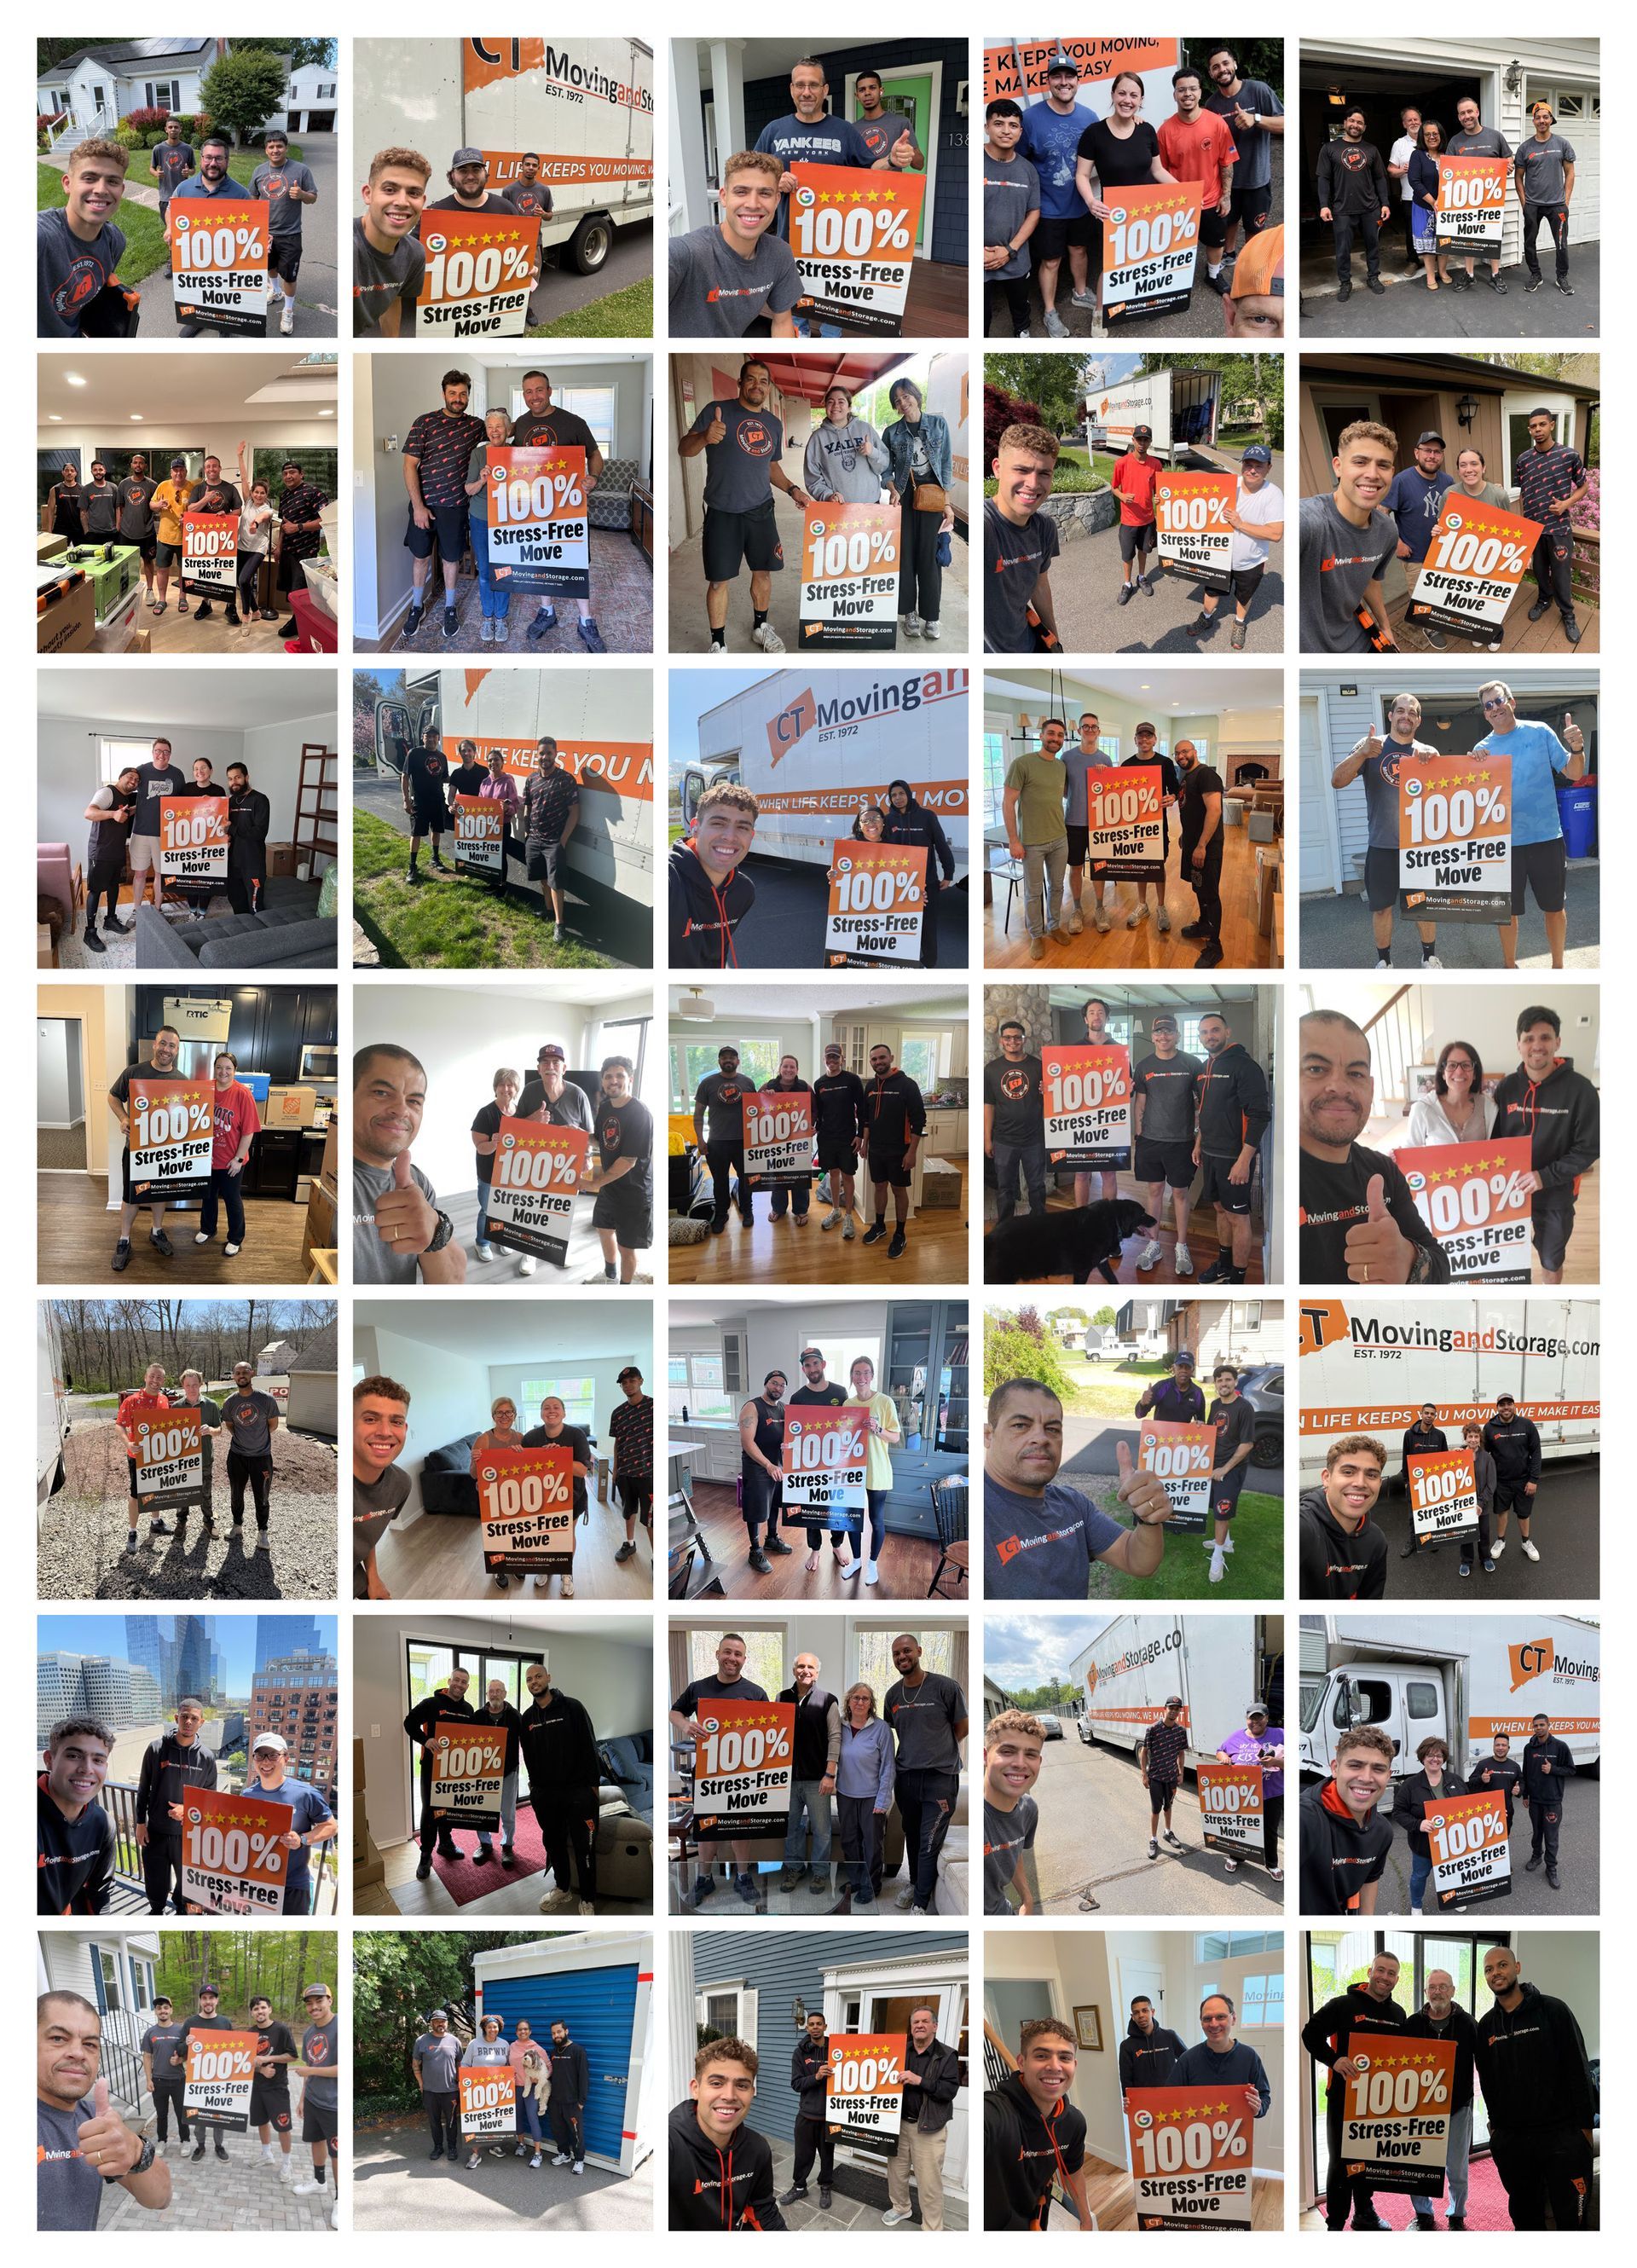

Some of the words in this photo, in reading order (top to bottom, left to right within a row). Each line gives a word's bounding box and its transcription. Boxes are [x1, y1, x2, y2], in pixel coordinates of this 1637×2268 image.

[998, 48, 1059, 71] KEEPS
[1063, 43, 1096, 61] YOU
[1102, 38, 1160, 52] MOVING,
[546, 84, 564, 98] EST.
[566, 90, 584, 103] 1972
[773, 136, 842, 153] YANKEES
[496, 161, 524, 179] LIF
[542, 163, 586, 177] KEEPS
[588, 163, 610, 176] YOU
[613, 165, 646, 176] MOVING,
[1442, 177, 1501, 208] 100%
[1440, 210, 1501, 223] Stress-Free
[795, 208, 910, 256] 100%
[1109, 208, 1195, 265] 100%
[1457, 223, 1485, 234] Move
[176, 227, 263, 269] 100%
[178, 273, 263, 287] Stress-Free
[425, 245, 529, 299] 100%
[796, 260, 904, 283] Stress-Free
[1109, 252, 1193, 288] Stress-Free
[824, 282, 874, 300] Move
[1135, 273, 1172, 295] Move
[202, 290, 241, 304] Move
[424, 293, 524, 324] Stress-Free
[454, 316, 500, 338] Move
[492, 473, 582, 523] 100%
[1160, 497, 1229, 530] 100%
[185, 531, 234, 556] 100%
[494, 522, 583, 546] Stress-Free
[1161, 534, 1229, 547] Stress-Free
[185, 558, 234, 569] Stress-Free
[520, 545, 562, 562] Move
[809, 530, 895, 577] 100%
[1179, 547, 1211, 560] Move
[1434, 531, 1527, 575] 100%
[199, 570, 222, 580] Move
[1423, 571, 1511, 599] Stress-Free
[807, 576, 894, 601] Stress-Free
[833, 599, 874, 617] Move
[1443, 592, 1485, 610] Move
[777, 706, 805, 742] CT
[818, 732, 835, 742] EST.
[838, 726, 859, 738] 1972
[574, 753, 629, 781] YOU
[760, 798, 789, 810] WHEN
[791, 797, 816, 809] LIFE
[820, 796, 867, 809] KEEPS
[1091, 787, 1158, 826] 100%
[1405, 785, 1506, 844] 100%
[164, 816, 225, 847] 100%
[457, 815, 500, 839] 100%
[1093, 824, 1159, 844] Stress-Free
[165, 847, 225, 862] Stress-Free
[456, 841, 500, 852] Stress-Free
[469, 852, 489, 862] Move
[1113, 842, 1143, 857] Move
[1406, 842, 1506, 869] Stress-Free
[182, 860, 211, 873] Move
[1436, 866, 1482, 886] Move
[836, 871, 919, 911] 100%
[833, 916, 917, 932] Stress-Free
[857, 934, 896, 951] Move
[1048, 1067, 1125, 1113] 100%
[135, 1103, 211, 1146] 100%
[747, 1108, 807, 1145] 100%
[1050, 1107, 1126, 1133] Stress-Free
[1073, 1129, 1108, 1145] Move
[136, 1142, 210, 1166] Stress-Free
[748, 1142, 808, 1160] Stress-Free
[159, 1160, 192, 1177] Move
[499, 1150, 576, 1188] 100%
[766, 1157, 795, 1170] Move
[494, 1190, 571, 1212] Stress-Free
[512, 1209, 549, 1227] Move
[1451, 1250, 1500, 1272] Move
[1354, 1350, 1377, 1358] EST.
[1380, 1350, 1402, 1359] 1972
[1312, 1414, 1351, 1427] LIFE
[1357, 1411, 1411, 1425] KEEPS
[1453, 1407, 1498, 1422] MOVIN
[1516, 1408, 1534, 1418] WE
[1537, 1406, 1568, 1416] MAKE
[1570, 1405, 1579, 1415] IT
[140, 1426, 198, 1463] 100%
[789, 1430, 864, 1469] 100%
[141, 1457, 200, 1480] Stress-Free
[1142, 1444, 1209, 1476] 100%
[159, 1473, 187, 1489] Move
[787, 1471, 862, 1488] Stress-Free
[1414, 1467, 1472, 1506] 100%
[483, 1472, 569, 1518] 100%
[809, 1488, 844, 1502] Move
[1172, 1495, 1189, 1506] ove
[1418, 1496, 1474, 1521] Stress-Free
[488, 1514, 569, 1537] Stress-Free
[1437, 1512, 1463, 1528] Move
[512, 1534, 550, 1549] Move
[1520, 1645, 1546, 1673] CT
[1490, 1722, 1524, 1732] WHEN
[1550, 1721, 1575, 1730] KEEPS
[1576, 1721, 1592, 1729] YOU
[702, 1727, 789, 1774] 100%
[437, 1746, 500, 1778] 100%
[436, 1779, 500, 1794] Stress-Free
[700, 1771, 788, 1796] Stress-Free
[454, 1794, 483, 1806] Move
[727, 1791, 767, 1810] Move
[1201, 1785, 1259, 1812] 100%
[1205, 1814, 1260, 1827] Stress-Free
[1220, 1826, 1246, 1837] Move
[1433, 1810, 1504, 1860] 100%
[187, 1825, 281, 1873] 100%
[1438, 1844, 1507, 1878] Stress-Free
[1461, 1864, 1492, 1883] Move
[187, 1868, 278, 1905] Stress-Free
[211, 1894, 252, 1915] Move
[191, 2051, 252, 2080] 100%
[831, 2057, 899, 2093] 100%
[188, 2083, 249, 2095] Stress-Free
[463, 2081, 512, 2110] 100%
[1351, 2068, 1447, 2116] 100%
[205, 2096, 232, 2107] Move
[830, 2096, 898, 2109] Stress-Free
[465, 2107, 513, 2123] Stress-Free
[480, 2120, 502, 2131] Move
[848, 2110, 879, 2124] Move
[1349, 2118, 1444, 2140] Stress-Free
[1136, 2118, 1247, 2174] 100%
[1377, 2139, 1420, 2158] Move
[1141, 2173, 1246, 2198] Stress-Free
[1171, 2196, 1219, 2213] Move
